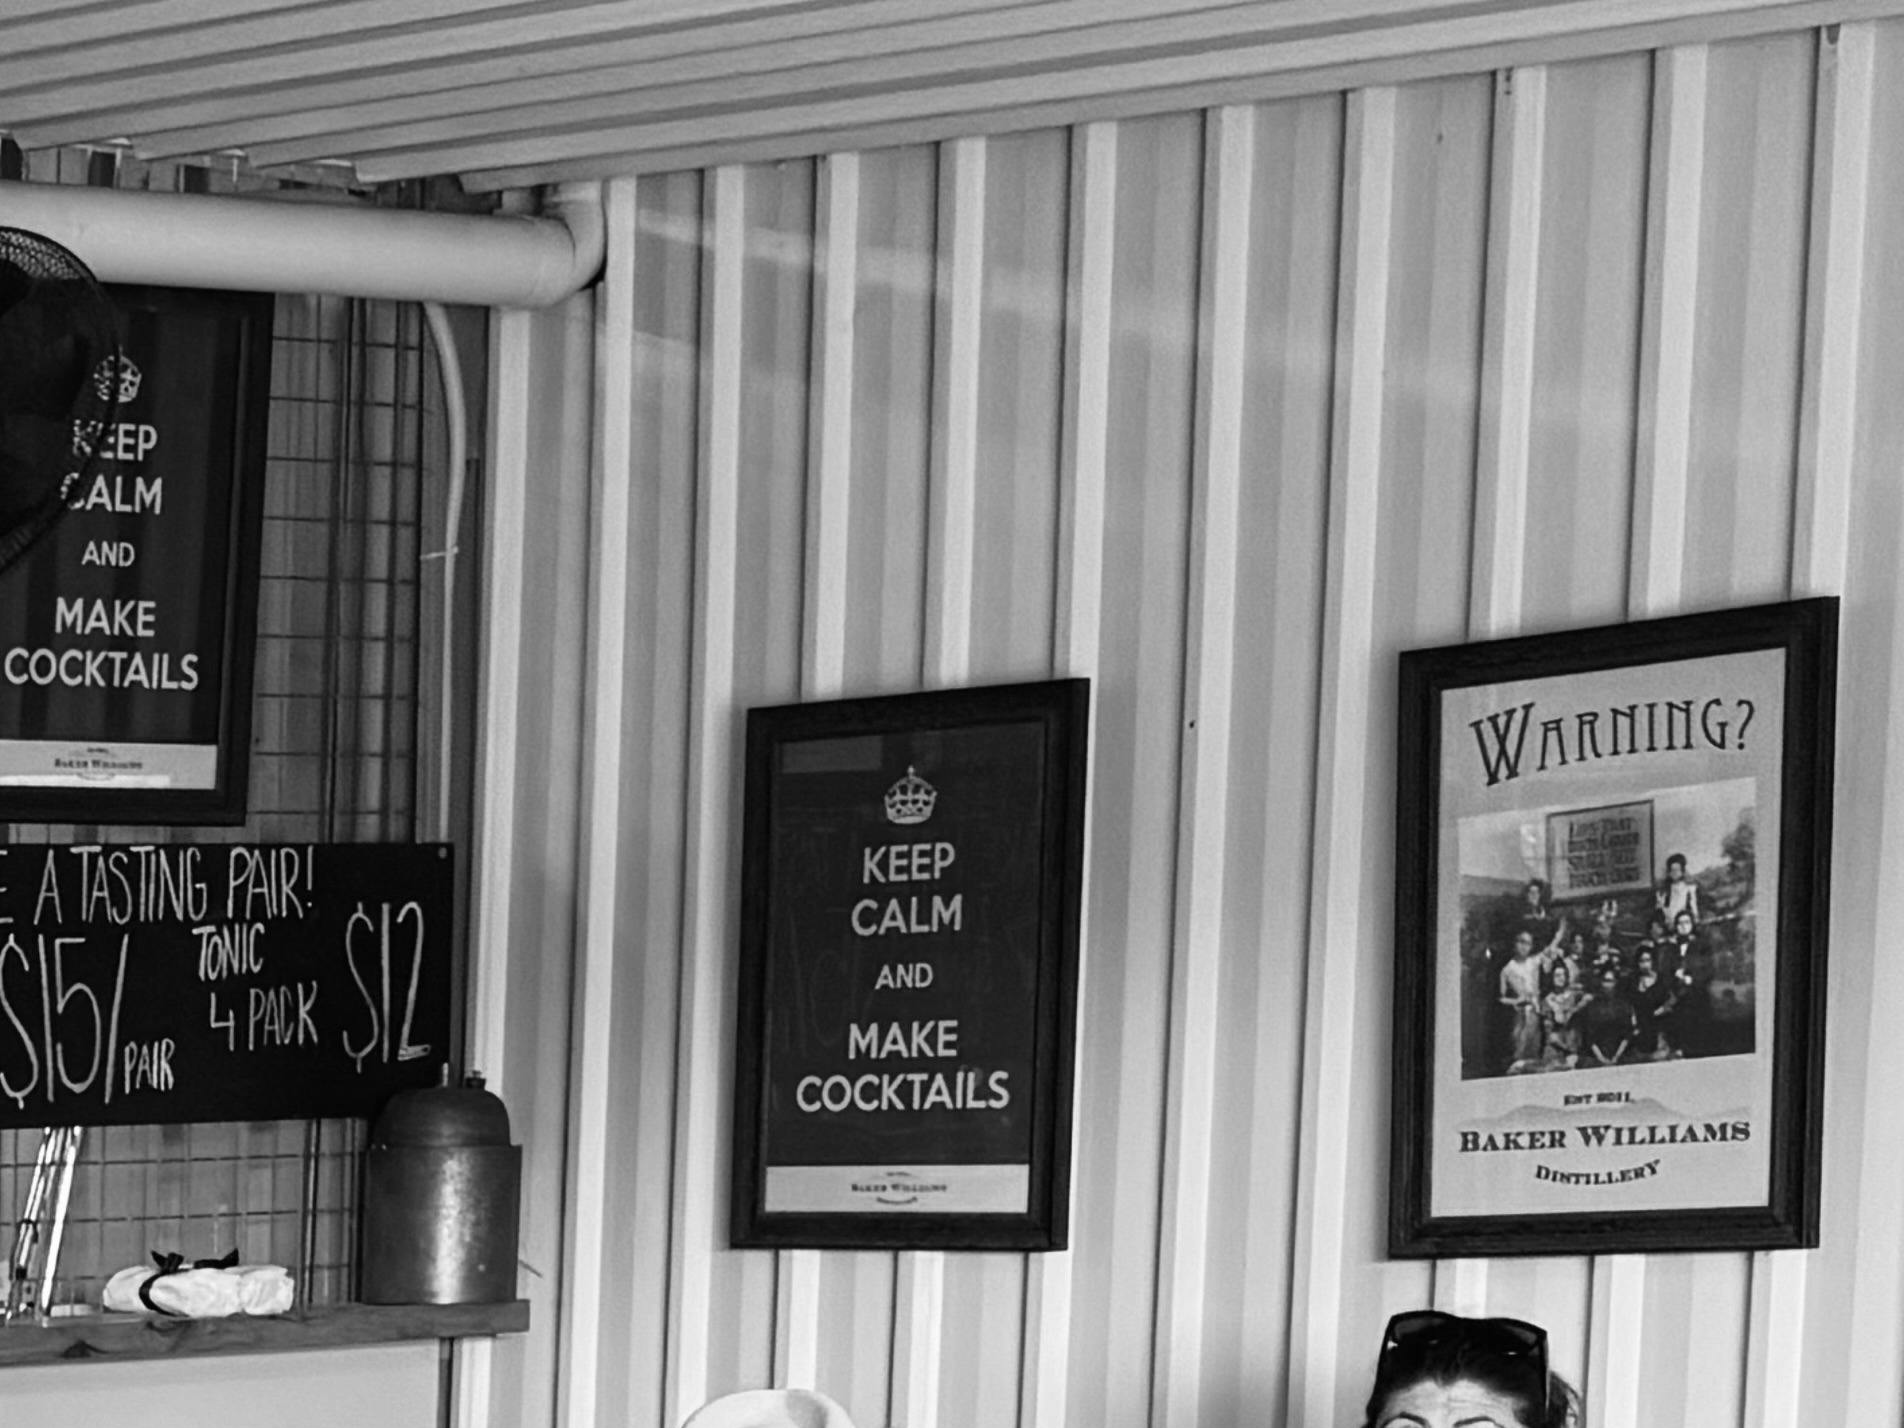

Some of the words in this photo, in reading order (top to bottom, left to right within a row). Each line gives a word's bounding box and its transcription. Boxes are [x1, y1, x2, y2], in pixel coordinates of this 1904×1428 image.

[73, 419, 157, 461] KEEP
[61, 472, 163, 515] CALM
[81, 540, 136, 567] AND
[55, 596, 157, 638] MAKE
[4, 646, 199, 691] COCKTAILS
[1469, 698, 1755, 787] WARNING?
[862, 841, 956, 884] KEEP
[32, 848, 63, 926] A
[69, 844, 208, 926] TASTING
[226, 845, 314, 920] PAIR!
[851, 893, 963, 937] CALM
[191, 921, 266, 982] TONIC
[342, 900, 431, 1074] $12
[874, 962, 934, 990] AND
[209, 991, 236, 1052] 4
[247, 980, 319, 1052] PACK
[848, 1019, 959, 1060] MAKE
[123, 1037, 176, 1095] PAIR
[796, 1070, 1010, 1113] COCKTAILS
[1459, 1129, 1566, 1153] BAKER
[1576, 1120, 1751, 1148] WILLIAMS
[1535, 1158, 1661, 1186] DISTILLERY
